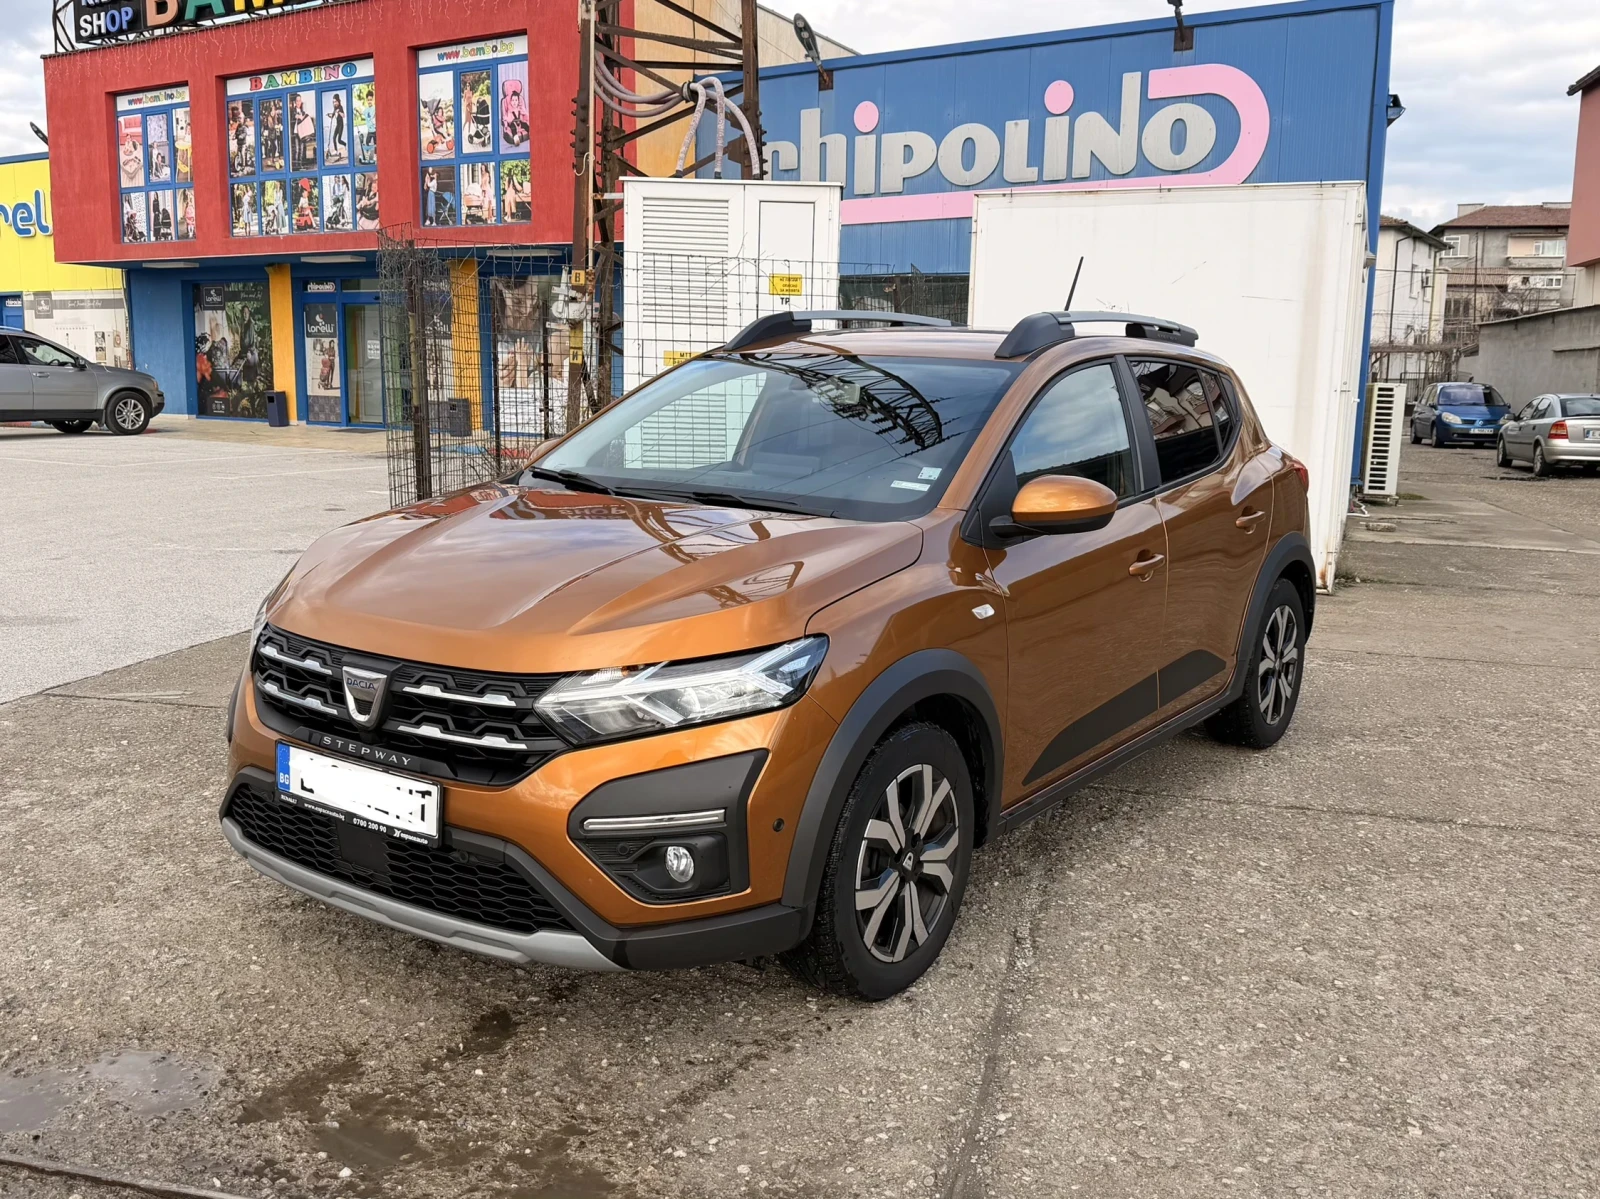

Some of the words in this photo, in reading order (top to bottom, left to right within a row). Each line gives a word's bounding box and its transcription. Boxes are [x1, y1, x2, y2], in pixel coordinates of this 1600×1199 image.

[80, 6, 133, 37] SHOP
[437, 41, 515, 61] www.bambo.bg
[249, 62, 357, 92] BAMBINO
[127, 89, 186, 106] www.bambino.bg
[346, 677, 376, 691] DACIA
[322, 735, 411, 766] STEPWAY
[279, 772, 290, 785] BG
[352, 817, 367, 828] 0700
[367, 822, 379, 831] 200
[379, 826, 387, 834] 90
